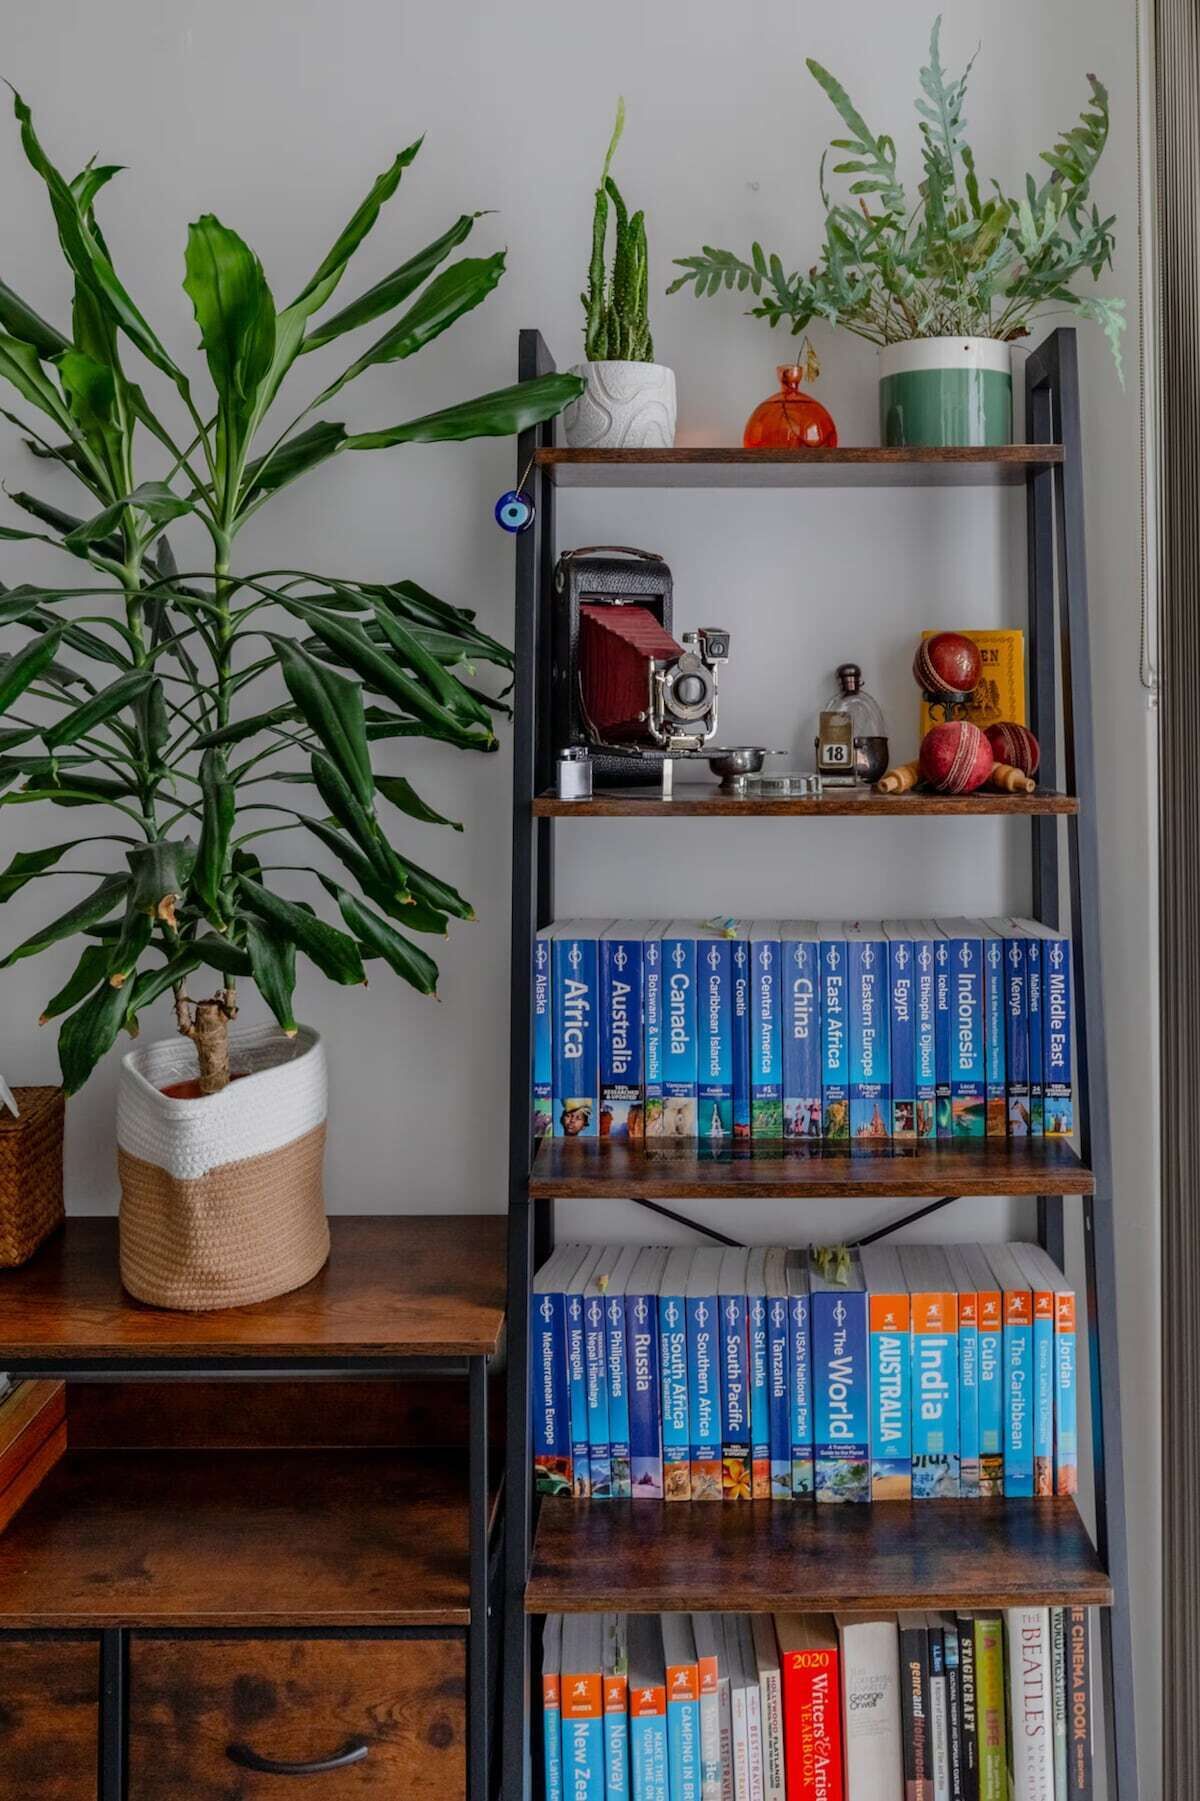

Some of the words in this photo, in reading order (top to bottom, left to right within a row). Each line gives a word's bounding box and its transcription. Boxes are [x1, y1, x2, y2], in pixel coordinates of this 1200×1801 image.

[826, 746, 843, 761] 18
[536, 974, 548, 1014] Alaska
[648, 974, 658, 1024] Botswana
[710, 975, 722, 1033] Caribbean
[736, 979, 746, 1016] Croatia
[761, 975, 773, 1019] Central
[793, 978, 813, 1039] China
[827, 976, 842, 1013] East
[861, 974, 874, 1025] Eastern
[896, 979, 911, 1022] Egypt
[919, 976, 931, 1020] Ethiopia
[938, 974, 948, 1010] Iceland
[1010, 977, 1022, 1016] Kenya
[1030, 973, 1040, 1012] Maldives
[1050, 974, 1065, 1029] Middle
[564, 978, 590, 1058] Africa
[612, 980, 632, 1074] Australia
[649, 1026, 658, 1034] &
[670, 973, 690, 1054] Canada
[921, 1023, 931, 1032] &
[958, 973, 977, 1069] Indonesia
[649, 1037, 659, 1080] Namibia
[711, 1037, 722, 1077] Islands
[762, 1022, 774, 1073] America
[828, 1018, 843, 1069] Africa
[861, 1029, 875, 1077] Europe
[920, 1035, 932, 1077] Djibouti
[1051, 1033, 1065, 1067] East
[570, 1329, 583, 1380] Mongolia
[587, 1332, 598, 1360] Nepal
[662, 1332, 670, 1366] Lesotho
[671, 1332, 684, 1379] South
[726, 1335, 741, 1379] South
[754, 1331, 765, 1348] Sri
[796, 1331, 807, 1361] USA's
[833, 1329, 846, 1356] The
[982, 1337, 997, 1380] Cuba
[1011, 1337, 1025, 1365] The
[542, 1332, 555, 1406] Mediterranean
[609, 1330, 622, 1397] Philippines
[635, 1334, 652, 1391] Russia
[697, 1332, 710, 1393] Southern
[755, 1351, 766, 1387] Lanka
[773, 1336, 787, 1397] Tanzania
[920, 1339, 949, 1420] India
[963, 1337, 975, 1385] Finland
[1060, 1337, 1074, 1388] Jordan
[588, 1363, 600, 1408] Himalaya
[663, 1377, 672, 1420] Swaziland
[797, 1363, 808, 1405] National
[828, 1356, 854, 1438] World
[879, 1336, 902, 1441] AUSTRALIA
[544, 1408, 556, 1444] Europe
[672, 1384, 686, 1429] Africa
[699, 1397, 712, 1437] Africa
[727, 1383, 743, 1431] Pacific
[798, 1408, 808, 1437] Parks
[1012, 1370, 1026, 1449] Caribbean
[1023, 1614, 1040, 1624] THE
[1054, 1611, 1064, 1649] WORLD
[1072, 1604, 1085, 1621] HE
[792, 1652, 829, 1669] 2020
[984, 1636, 998, 1649] A
[1072, 1625, 1085, 1689] CINEMA
[961, 1638, 975, 1732] STAGECRAFT
[1022, 1627, 1045, 1737] BEATLES
[1055, 1653, 1065, 1681] PRESS
[811, 1673, 829, 1741] Writers'
[849, 1692, 884, 1702] George
[849, 1701, 877, 1711] Orwell
[1073, 1692, 1086, 1740] BOOK
[574, 1723, 590, 1763] New
[643, 1727, 654, 1754] YOUR
[654, 1731, 664, 1760] MAKE
[681, 1706, 693, 1762] CAMPING
[720, 1728, 729, 1755] BEST
[750, 1725, 759, 1751] BEST
[800, 1703, 814, 1787] YEARBOOK
[550, 1759, 559, 1785] Latin
[608, 1724, 626, 1792] Norway
[645, 1759, 655, 1783] TIME
[655, 1764, 664, 1784] THE
[683, 1766, 693, 1779] IN
[706, 1761, 717, 1792] Here
[814, 1756, 831, 1801] Artist
[1027, 1744, 1037, 1801] ARCHIV
[575, 1768, 591, 1801] Zea
[646, 1785, 655, 1800] ON
[656, 1787, 665, 1801] MO
[683, 1783, 694, 1801] BR
[738, 1769, 747, 1801] TRAVE
